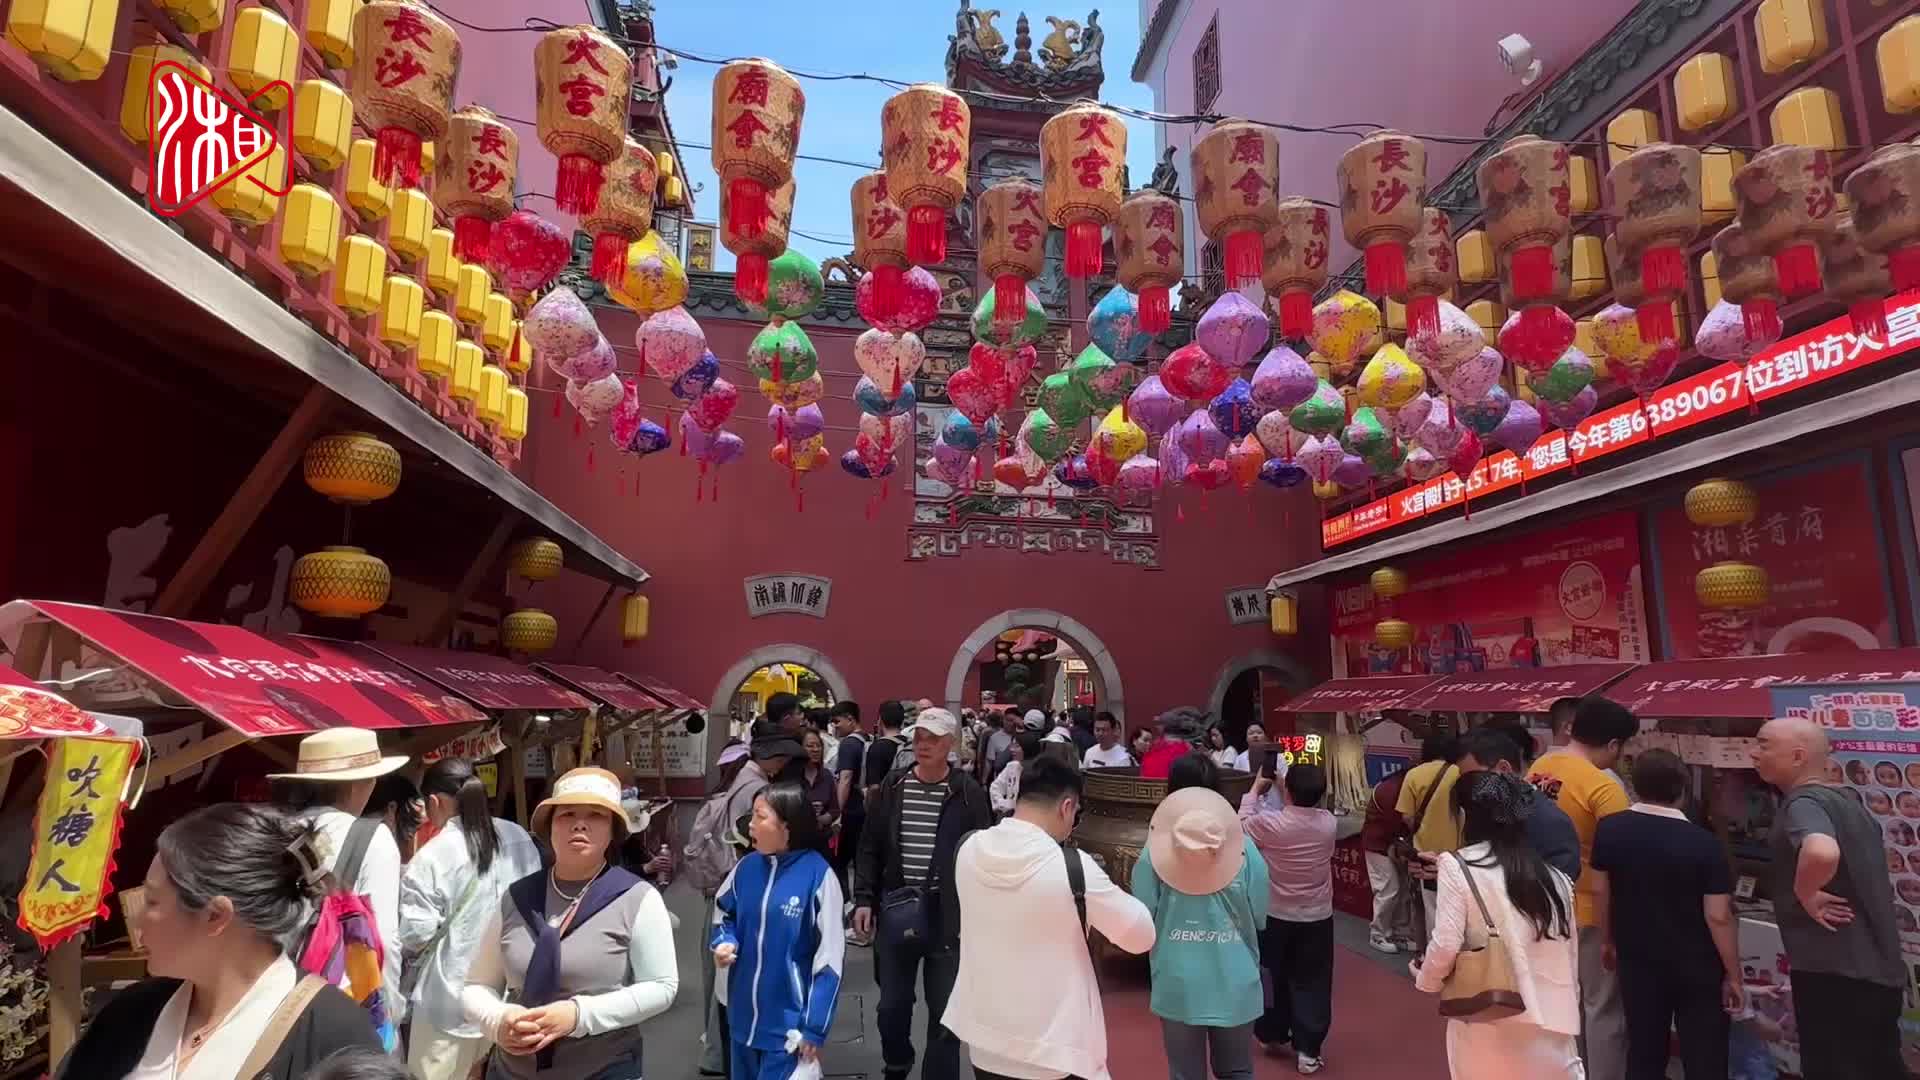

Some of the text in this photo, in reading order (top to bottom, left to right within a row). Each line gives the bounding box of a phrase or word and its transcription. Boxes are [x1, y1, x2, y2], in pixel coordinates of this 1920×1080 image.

[375, 6, 437, 89] 長沙
[727, 67, 770, 149] 廟會
[927, 96, 963, 176] 長沙
[469, 123, 506, 194] 長沙
[1229, 132, 1271, 207] 廟會
[1371, 138, 1410, 213] 長沙
[1145, 201, 1178, 265] 廟會
[1304, 207, 1329, 271] 長沙
[36, 754, 103, 893] 吹糖人
